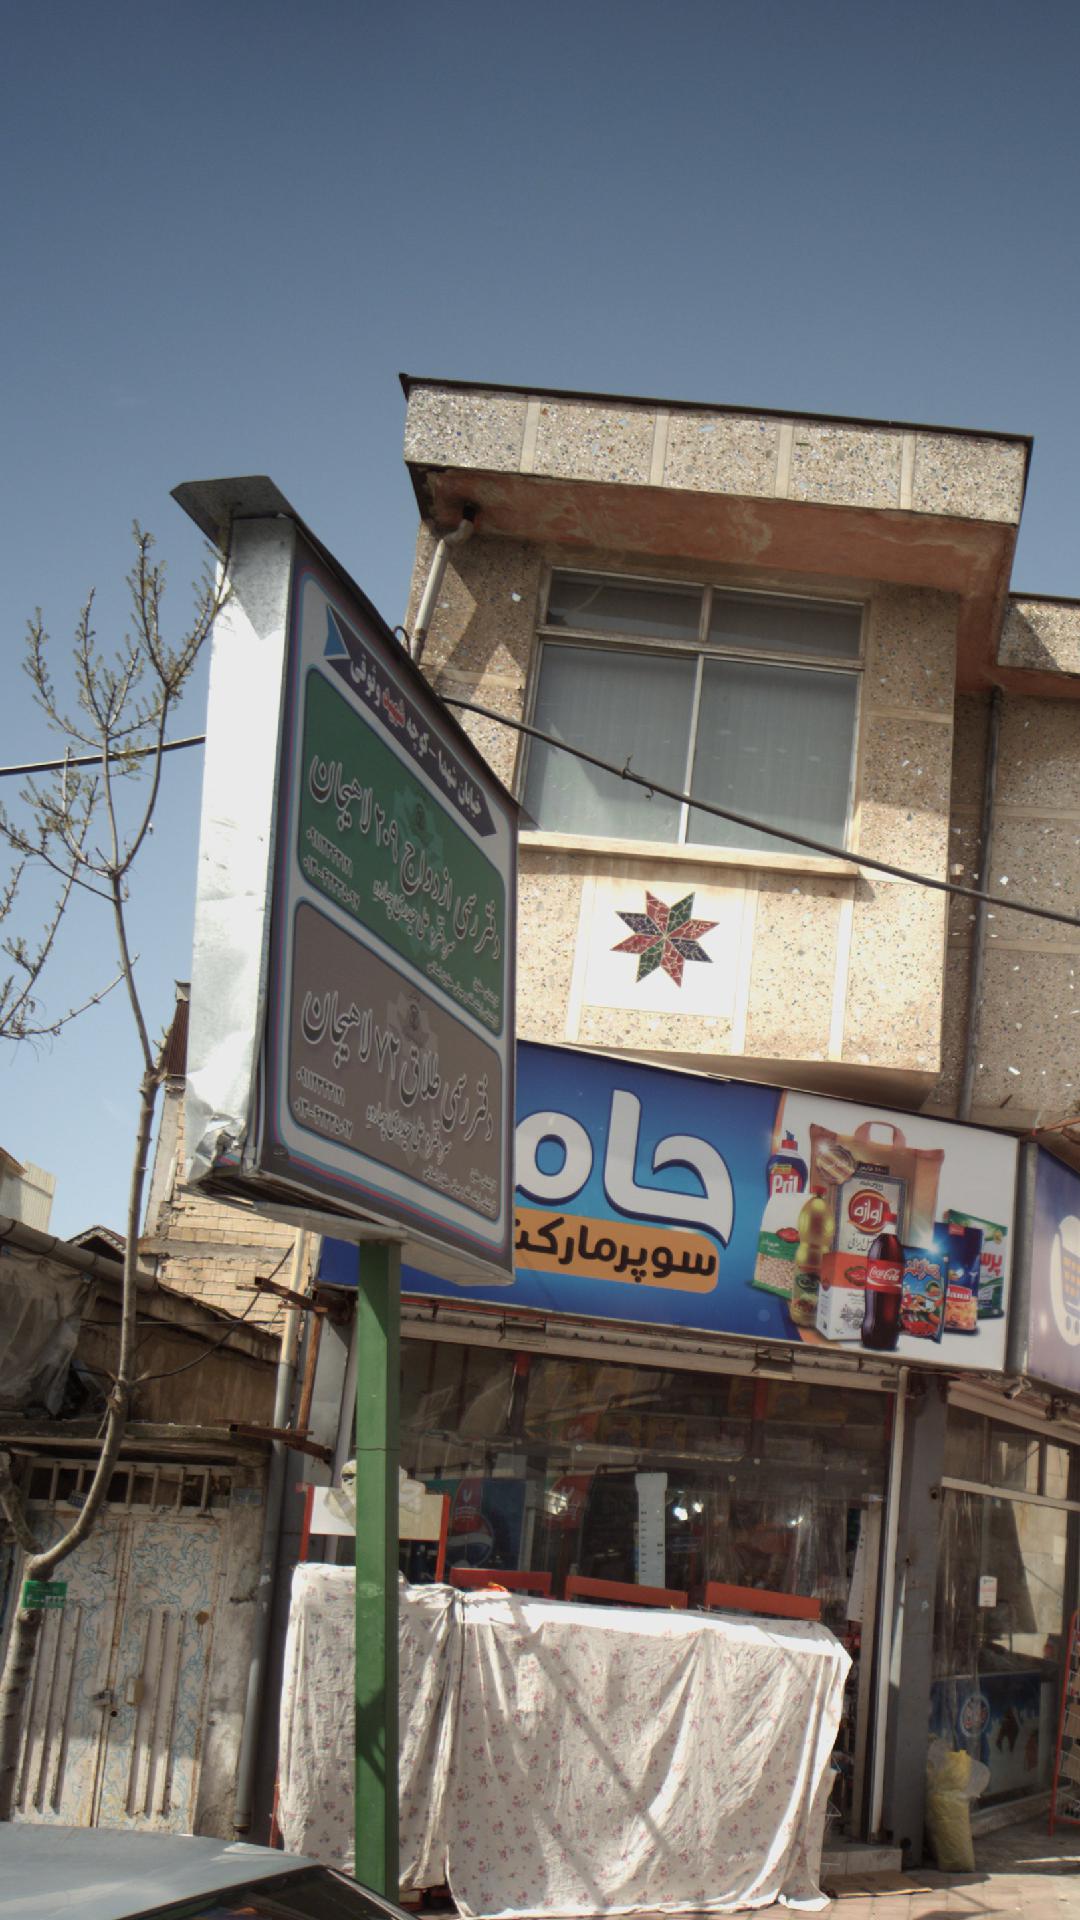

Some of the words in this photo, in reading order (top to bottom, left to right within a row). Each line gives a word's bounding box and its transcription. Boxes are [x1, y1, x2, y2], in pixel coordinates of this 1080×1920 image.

[406, 718, 429, 757] کوچه
[309, 755, 373, 834] لاهیجان
[438, 750, 457, 789] شهدا
[458, 782, 481, 818] خیابان
[375, 803, 400, 864] ۲۰۹
[401, 841, 453, 912] ازدواج
[454, 893, 478, 939] رسمی
[473, 900, 500, 960] دفتر
[301, 990, 373, 1069] لاهیجان
[375, 1025, 401, 1082] ۷۲
[399, 1045, 441, 1107] طلاق
[441, 1073, 468, 1132] رسمی
[464, 1073, 493, 1141] دفتر
[515, 1089, 734, 1249] حام
[772, 1174, 799, 1194] Pril
